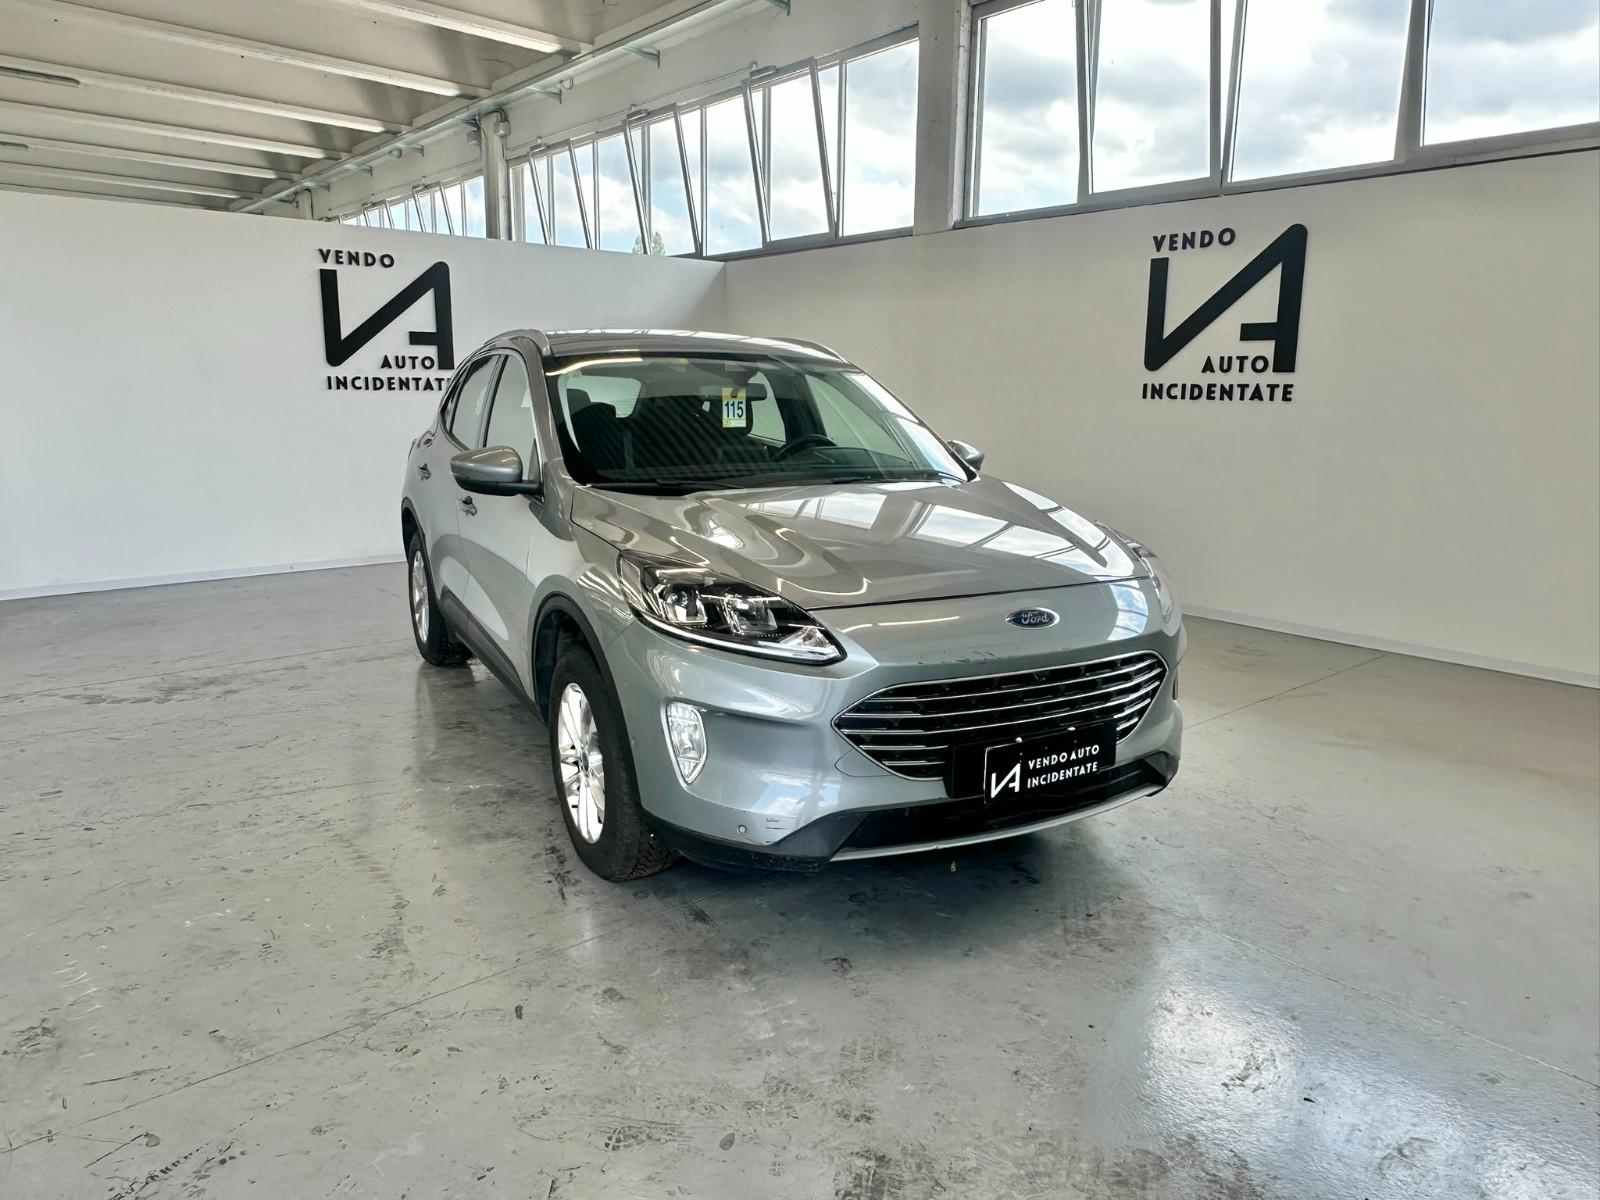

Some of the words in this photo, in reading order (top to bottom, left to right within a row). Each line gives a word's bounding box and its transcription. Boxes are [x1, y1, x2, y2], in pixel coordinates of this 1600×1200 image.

[1152, 227, 1236, 252] VENDO
[319, 248, 394, 268] VENDO
[380, 354, 435, 370] AUTO
[1201, 355, 1269, 373] AUTO
[1142, 383, 1294, 401] INCIDENTATE
[725, 400, 744, 418] 115
[1021, 611, 1050, 624] Ford
[1028, 753, 1068, 769] VENDO
[1070, 744, 1100, 761] AUTO
[1027, 761, 1099, 789] INCIDENTATE
